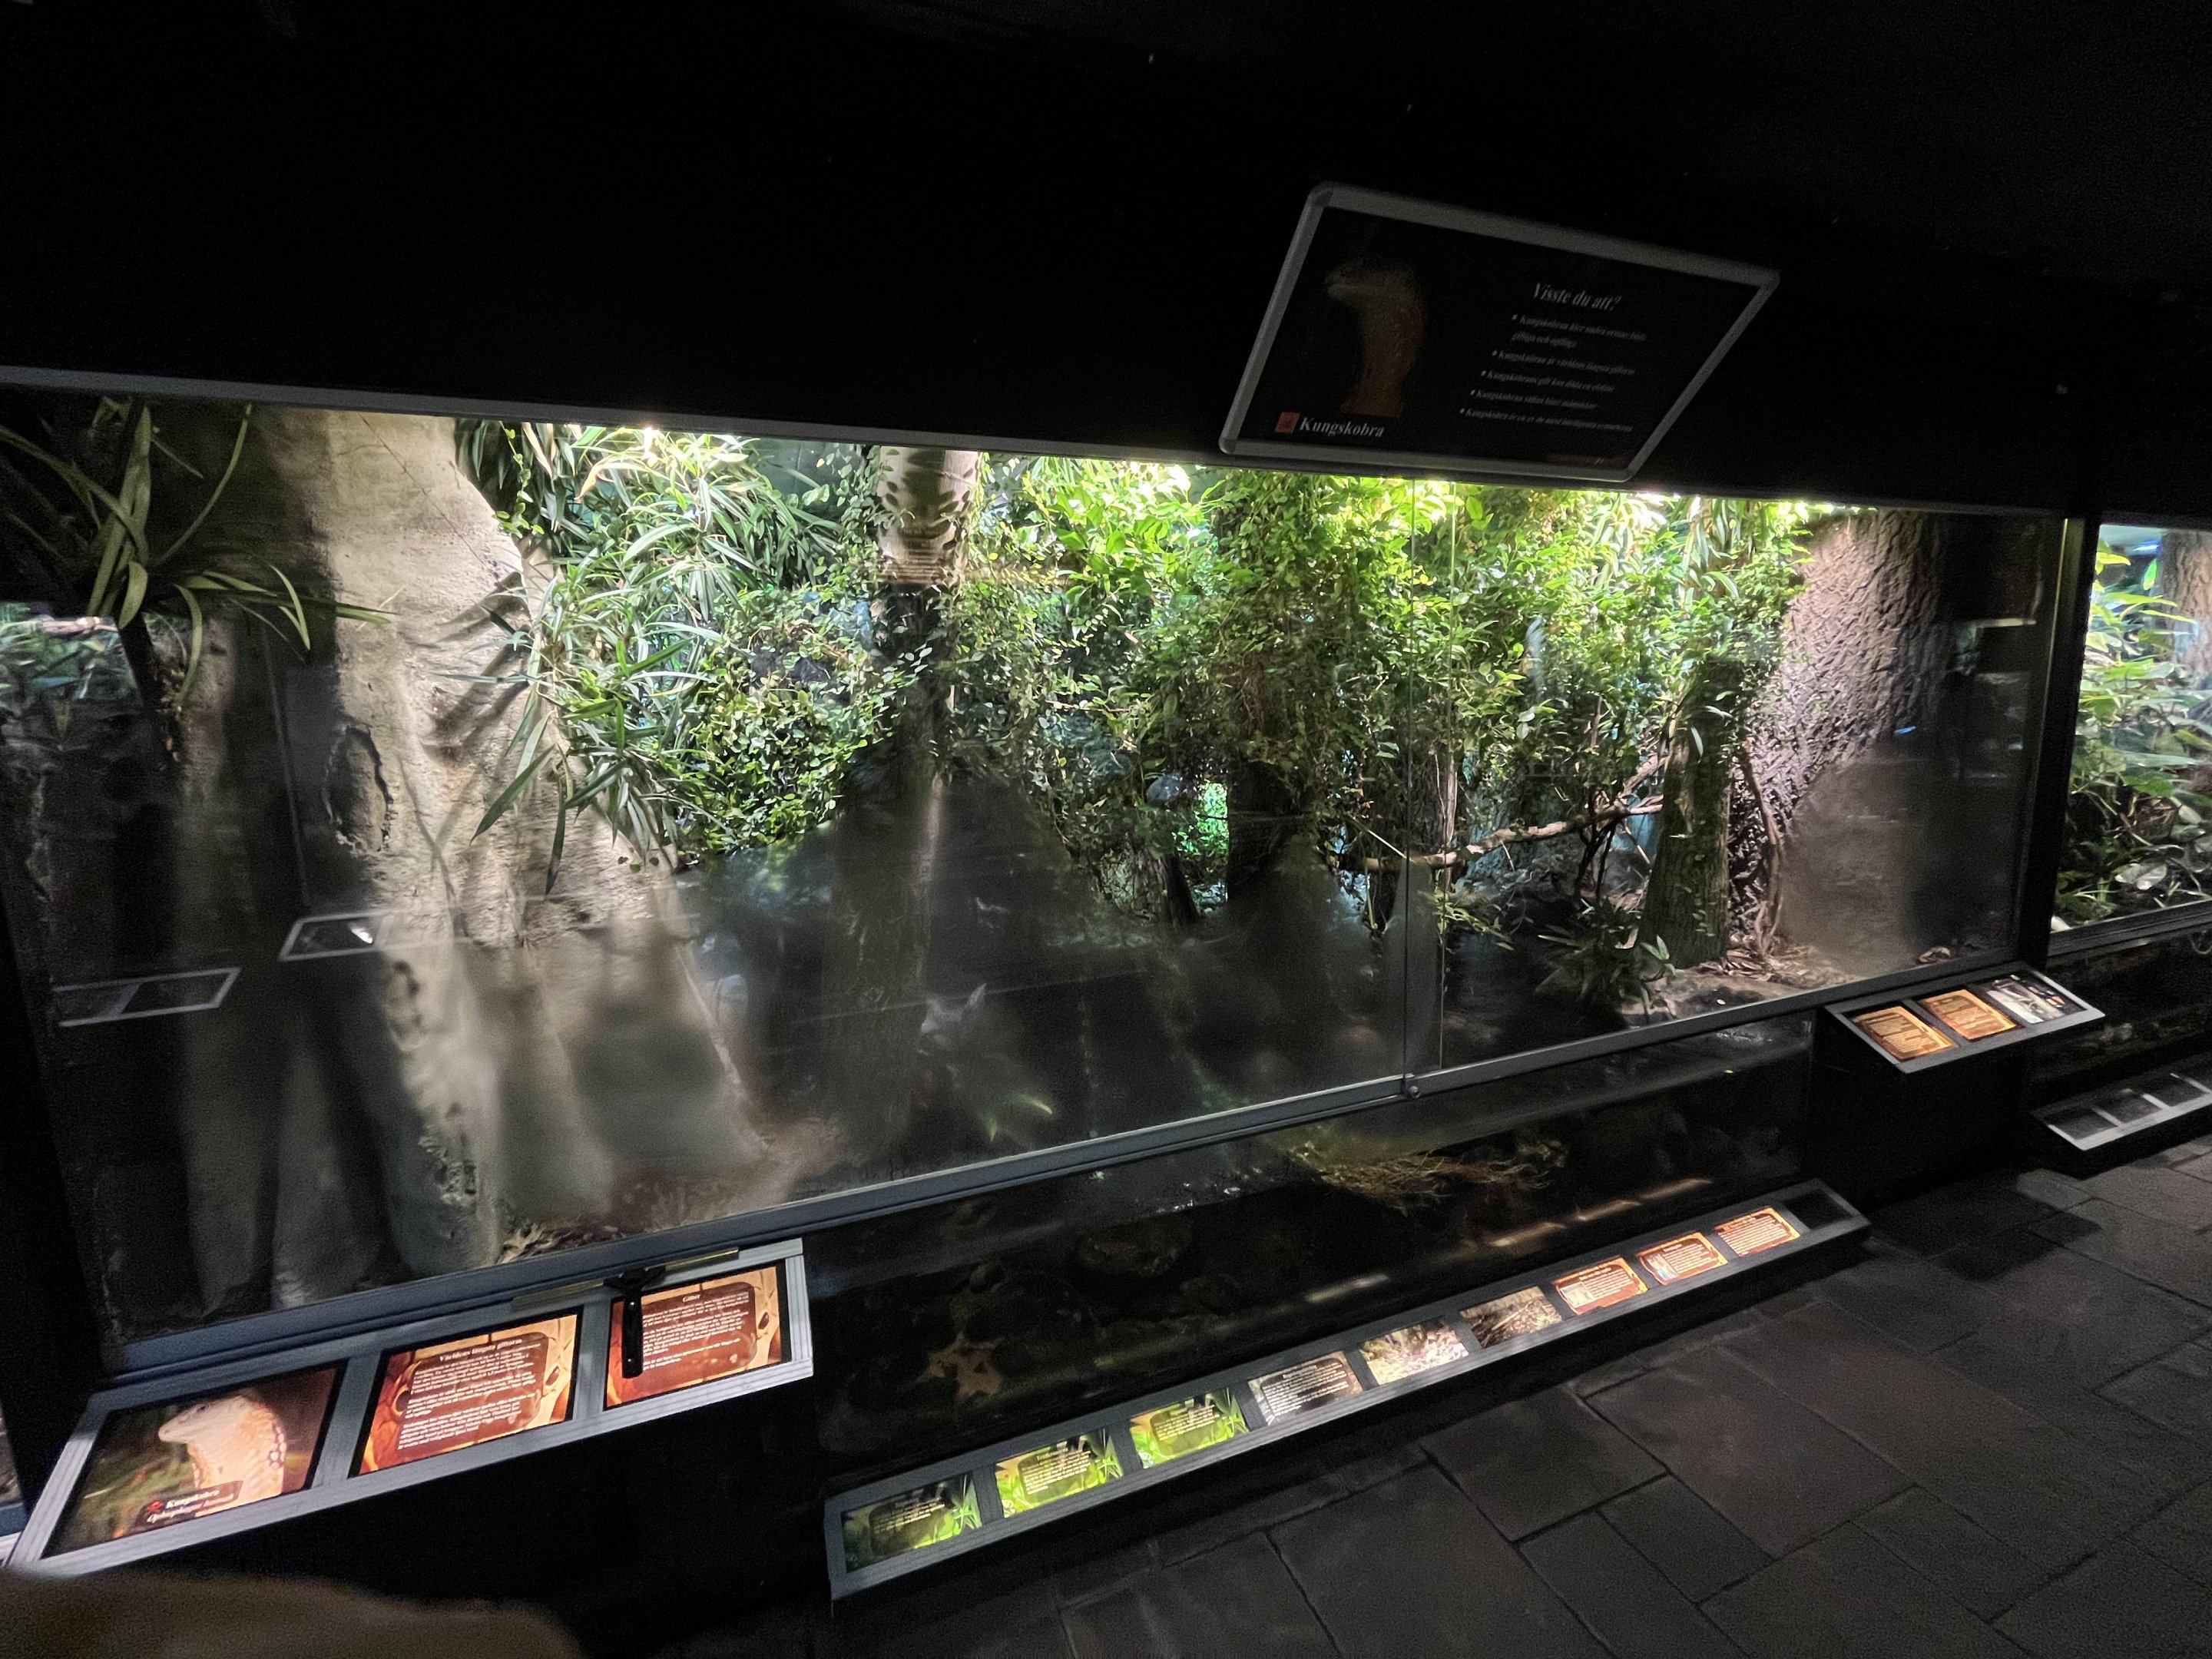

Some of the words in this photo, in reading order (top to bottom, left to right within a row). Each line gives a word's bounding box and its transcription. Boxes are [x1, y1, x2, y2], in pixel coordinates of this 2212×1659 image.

[1534, 282, 1571, 303] Visste
[1572, 290, 1591, 306] du
[1591, 295, 1622, 311] att?
[1299, 416, 1384, 438] Kungskobra
